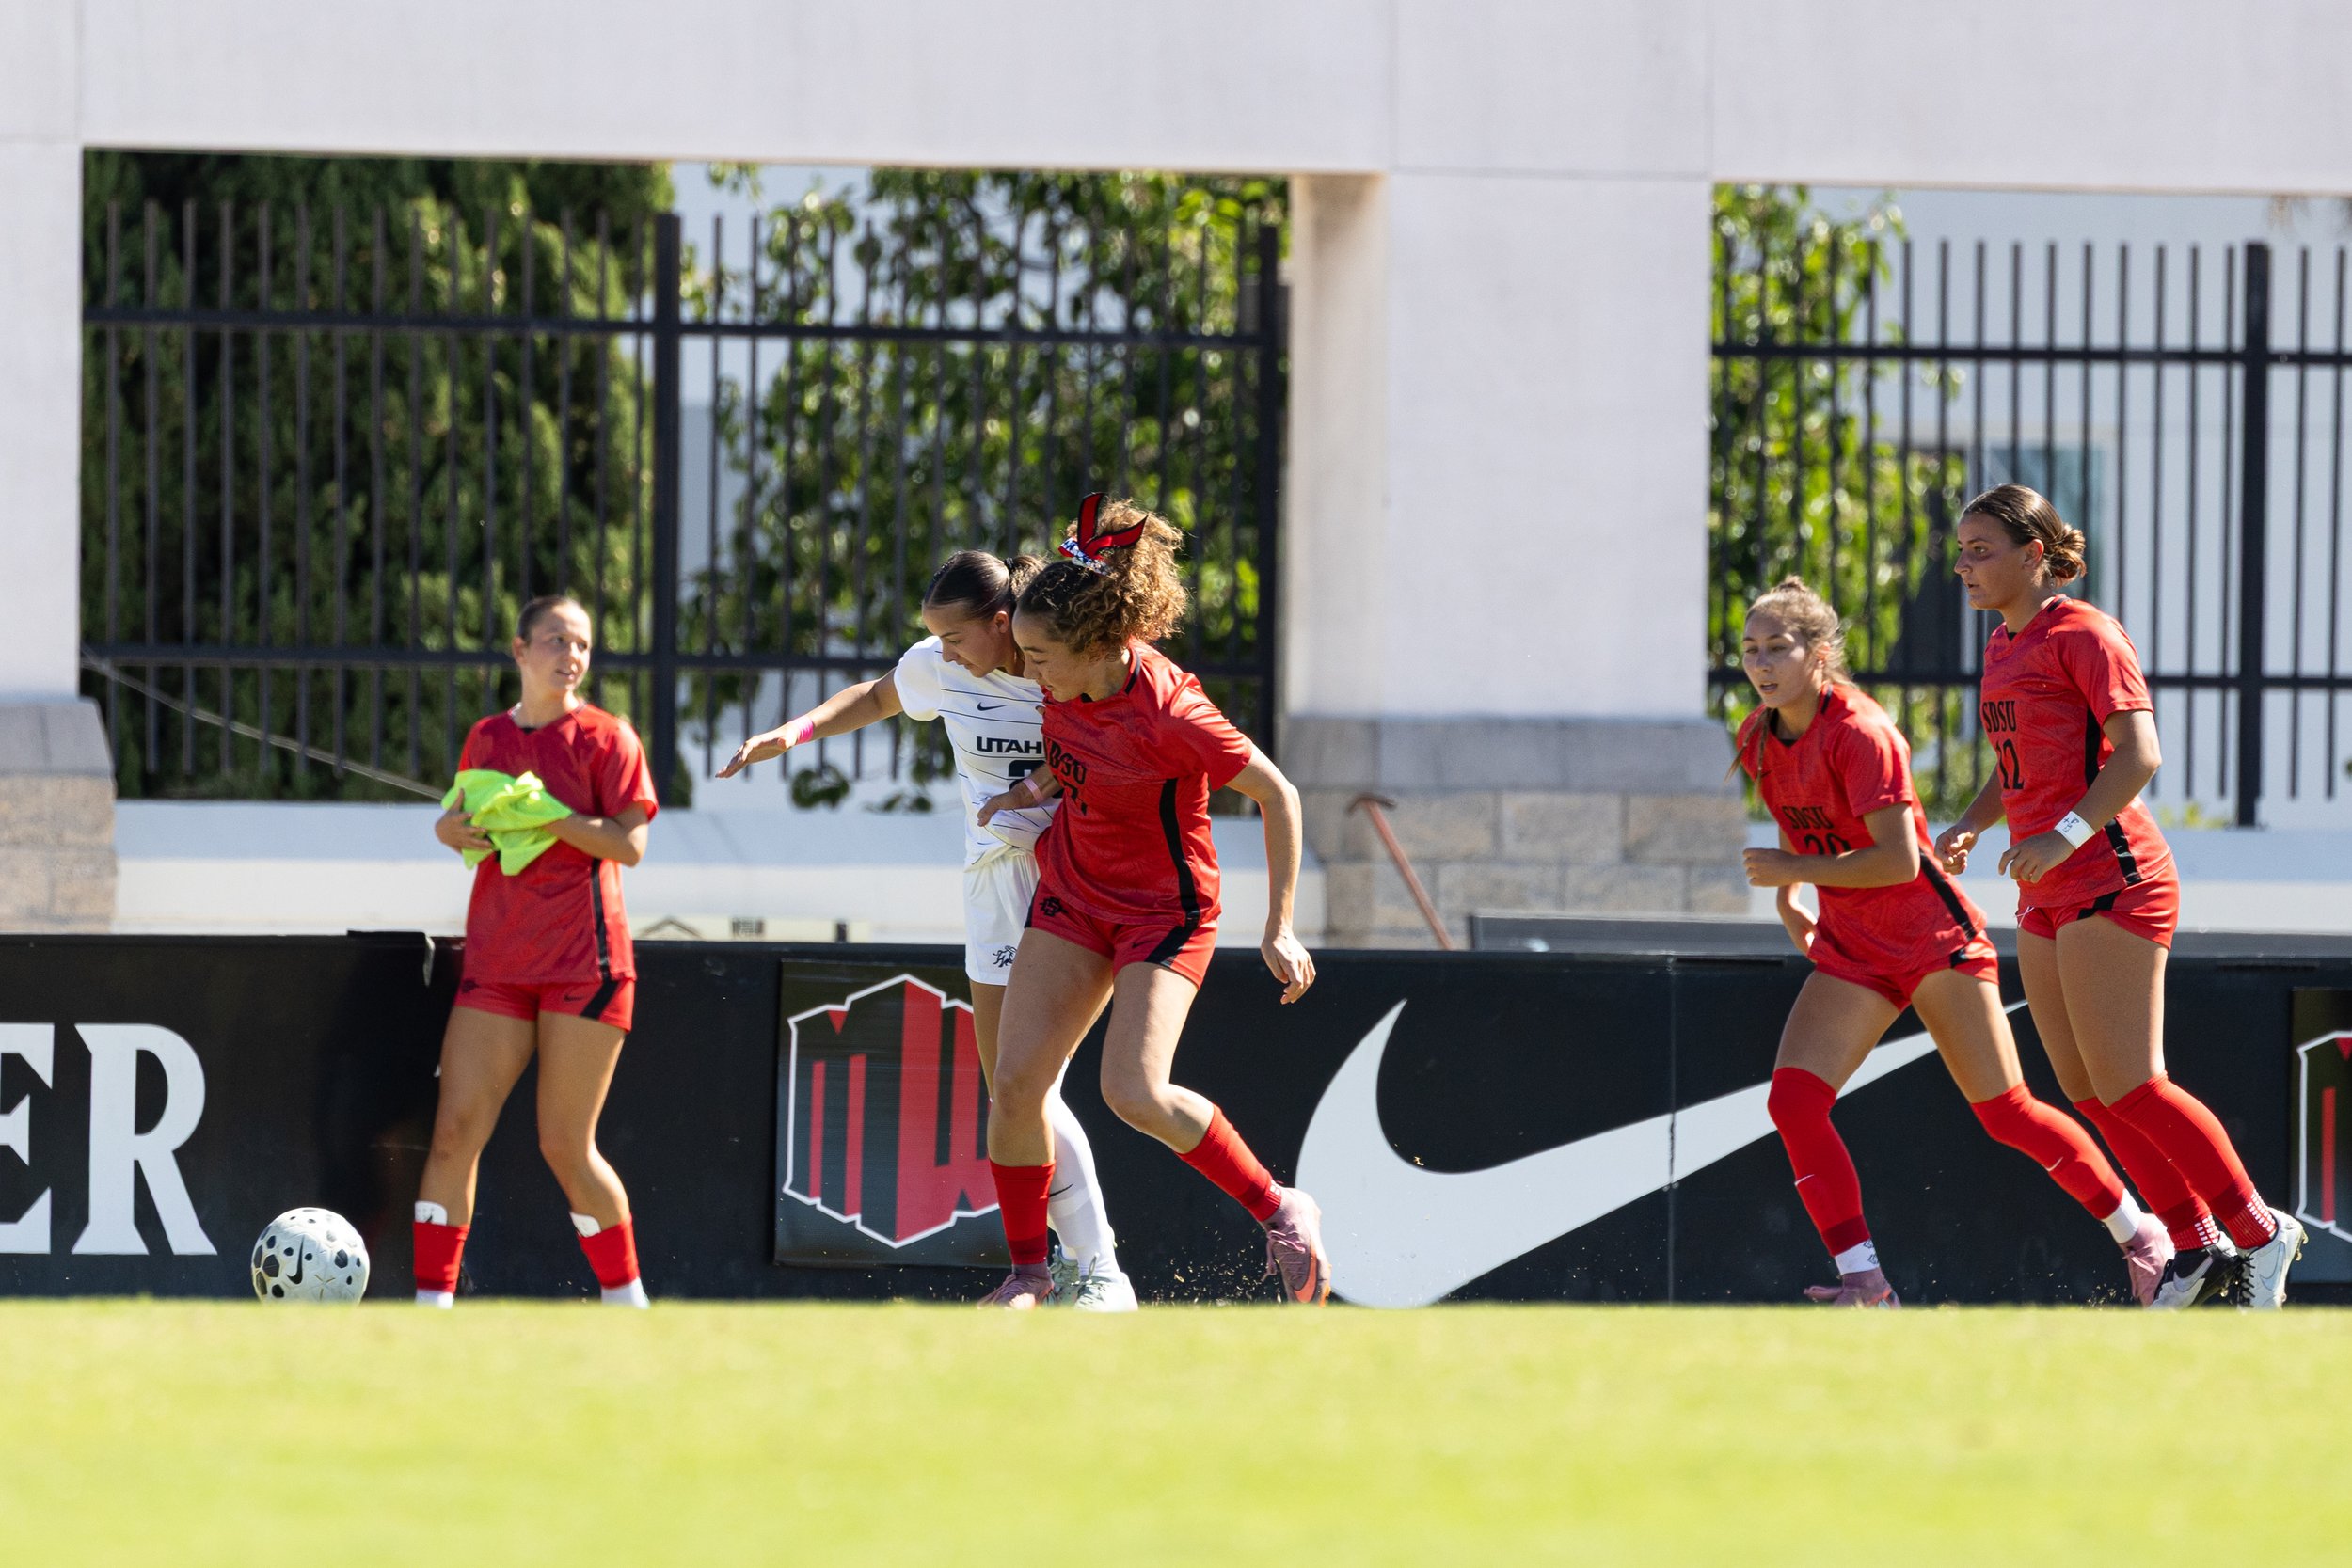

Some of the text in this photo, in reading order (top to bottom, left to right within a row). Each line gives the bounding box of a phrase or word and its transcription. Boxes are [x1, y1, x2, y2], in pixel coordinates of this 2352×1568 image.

[1982, 701, 2017, 733] SDSU
[977, 736, 1042, 754] UTAH
[1043, 736, 1088, 785] DSU
[1995, 739, 2025, 790] 12
[1782, 805, 1834, 829] SDSU
